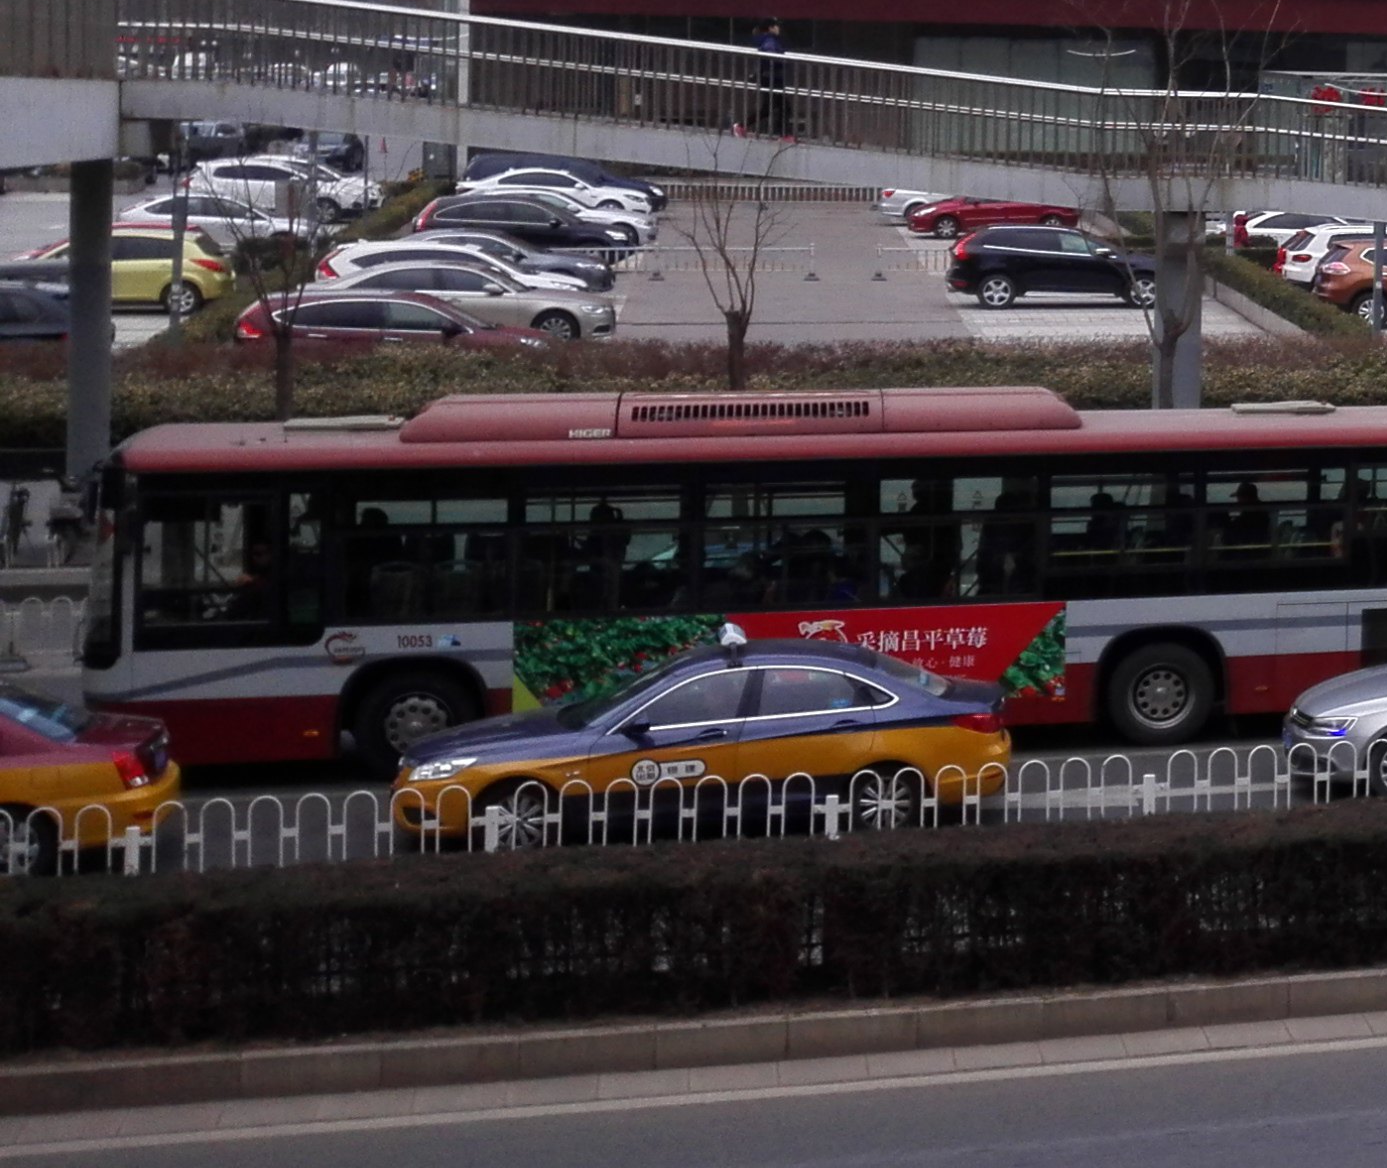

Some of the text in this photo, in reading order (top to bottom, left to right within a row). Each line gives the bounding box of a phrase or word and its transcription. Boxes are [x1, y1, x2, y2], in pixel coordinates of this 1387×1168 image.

[569, 428, 611, 438] HIGER
[397, 635, 433, 648] 10053
[857, 627, 988, 652] 采摘昌平草莓
